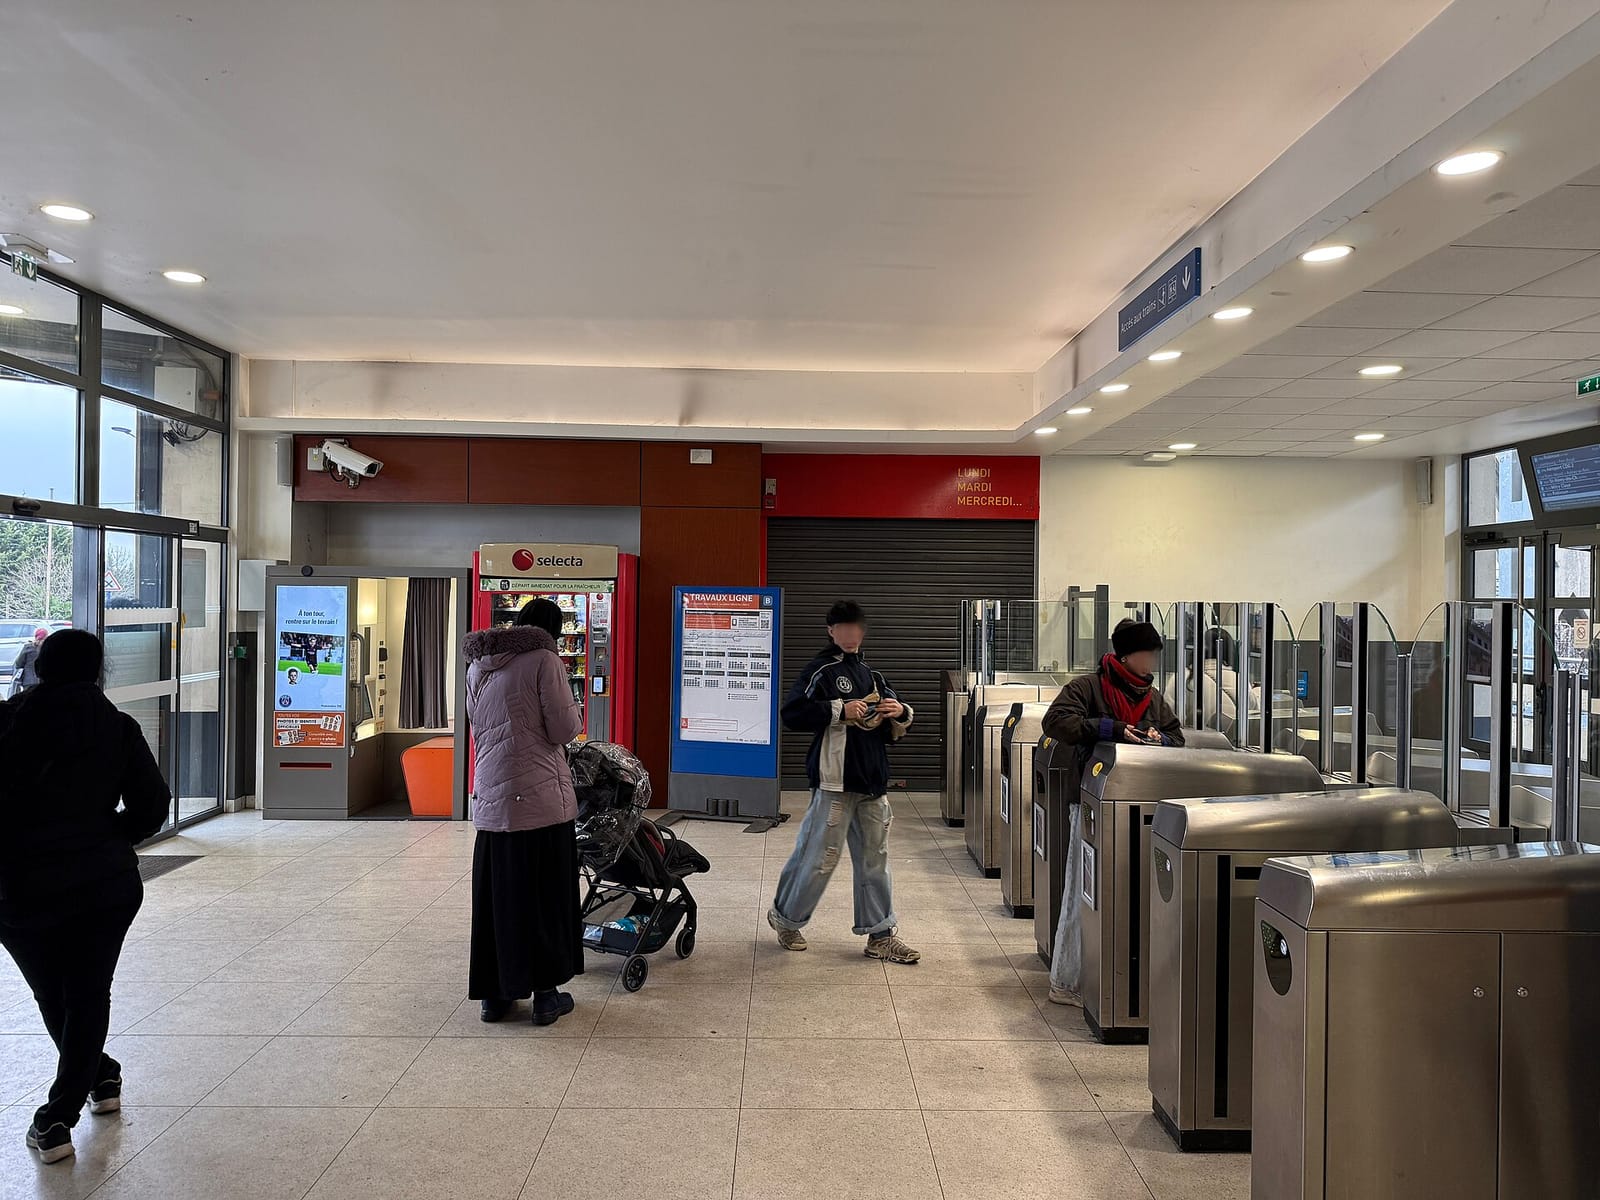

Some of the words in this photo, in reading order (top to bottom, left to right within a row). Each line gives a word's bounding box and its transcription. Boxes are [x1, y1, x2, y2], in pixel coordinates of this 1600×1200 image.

[1120, 317, 1133, 333] Accès
[1133, 312, 1142, 325] aux
[1142, 300, 1156, 317] trains
[957, 468, 991, 478] LUNDI
[957, 482, 992, 492] MARDI
[957, 496, 1022, 506] MERCREDI...
[536, 555, 583, 567] selecta
[690, 593, 728, 602] TRAVAUX
[728, 594, 753, 602] LIGNE
